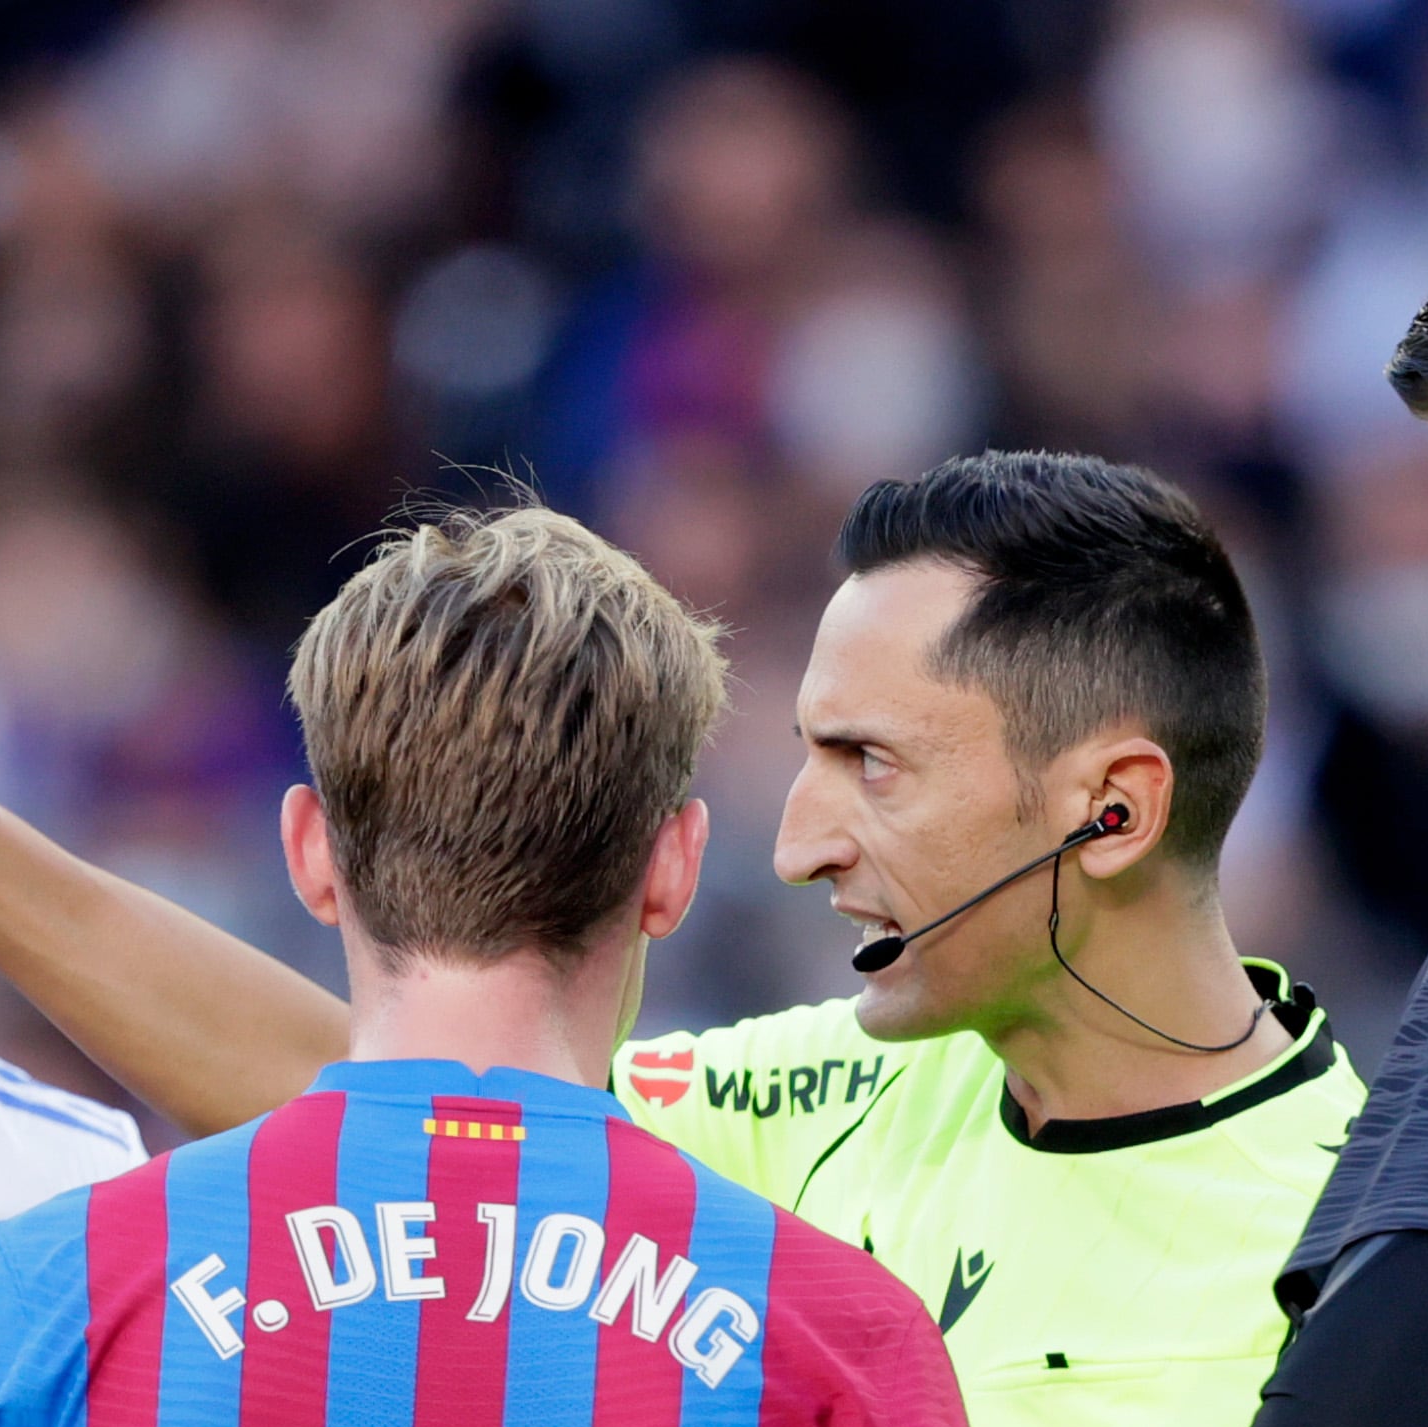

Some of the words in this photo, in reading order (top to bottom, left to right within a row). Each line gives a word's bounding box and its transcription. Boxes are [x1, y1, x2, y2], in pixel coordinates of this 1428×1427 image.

[172, 1252, 290, 1361] F.
[284, 1202, 446, 1312] DE
[466, 1202, 760, 1390] JONG
